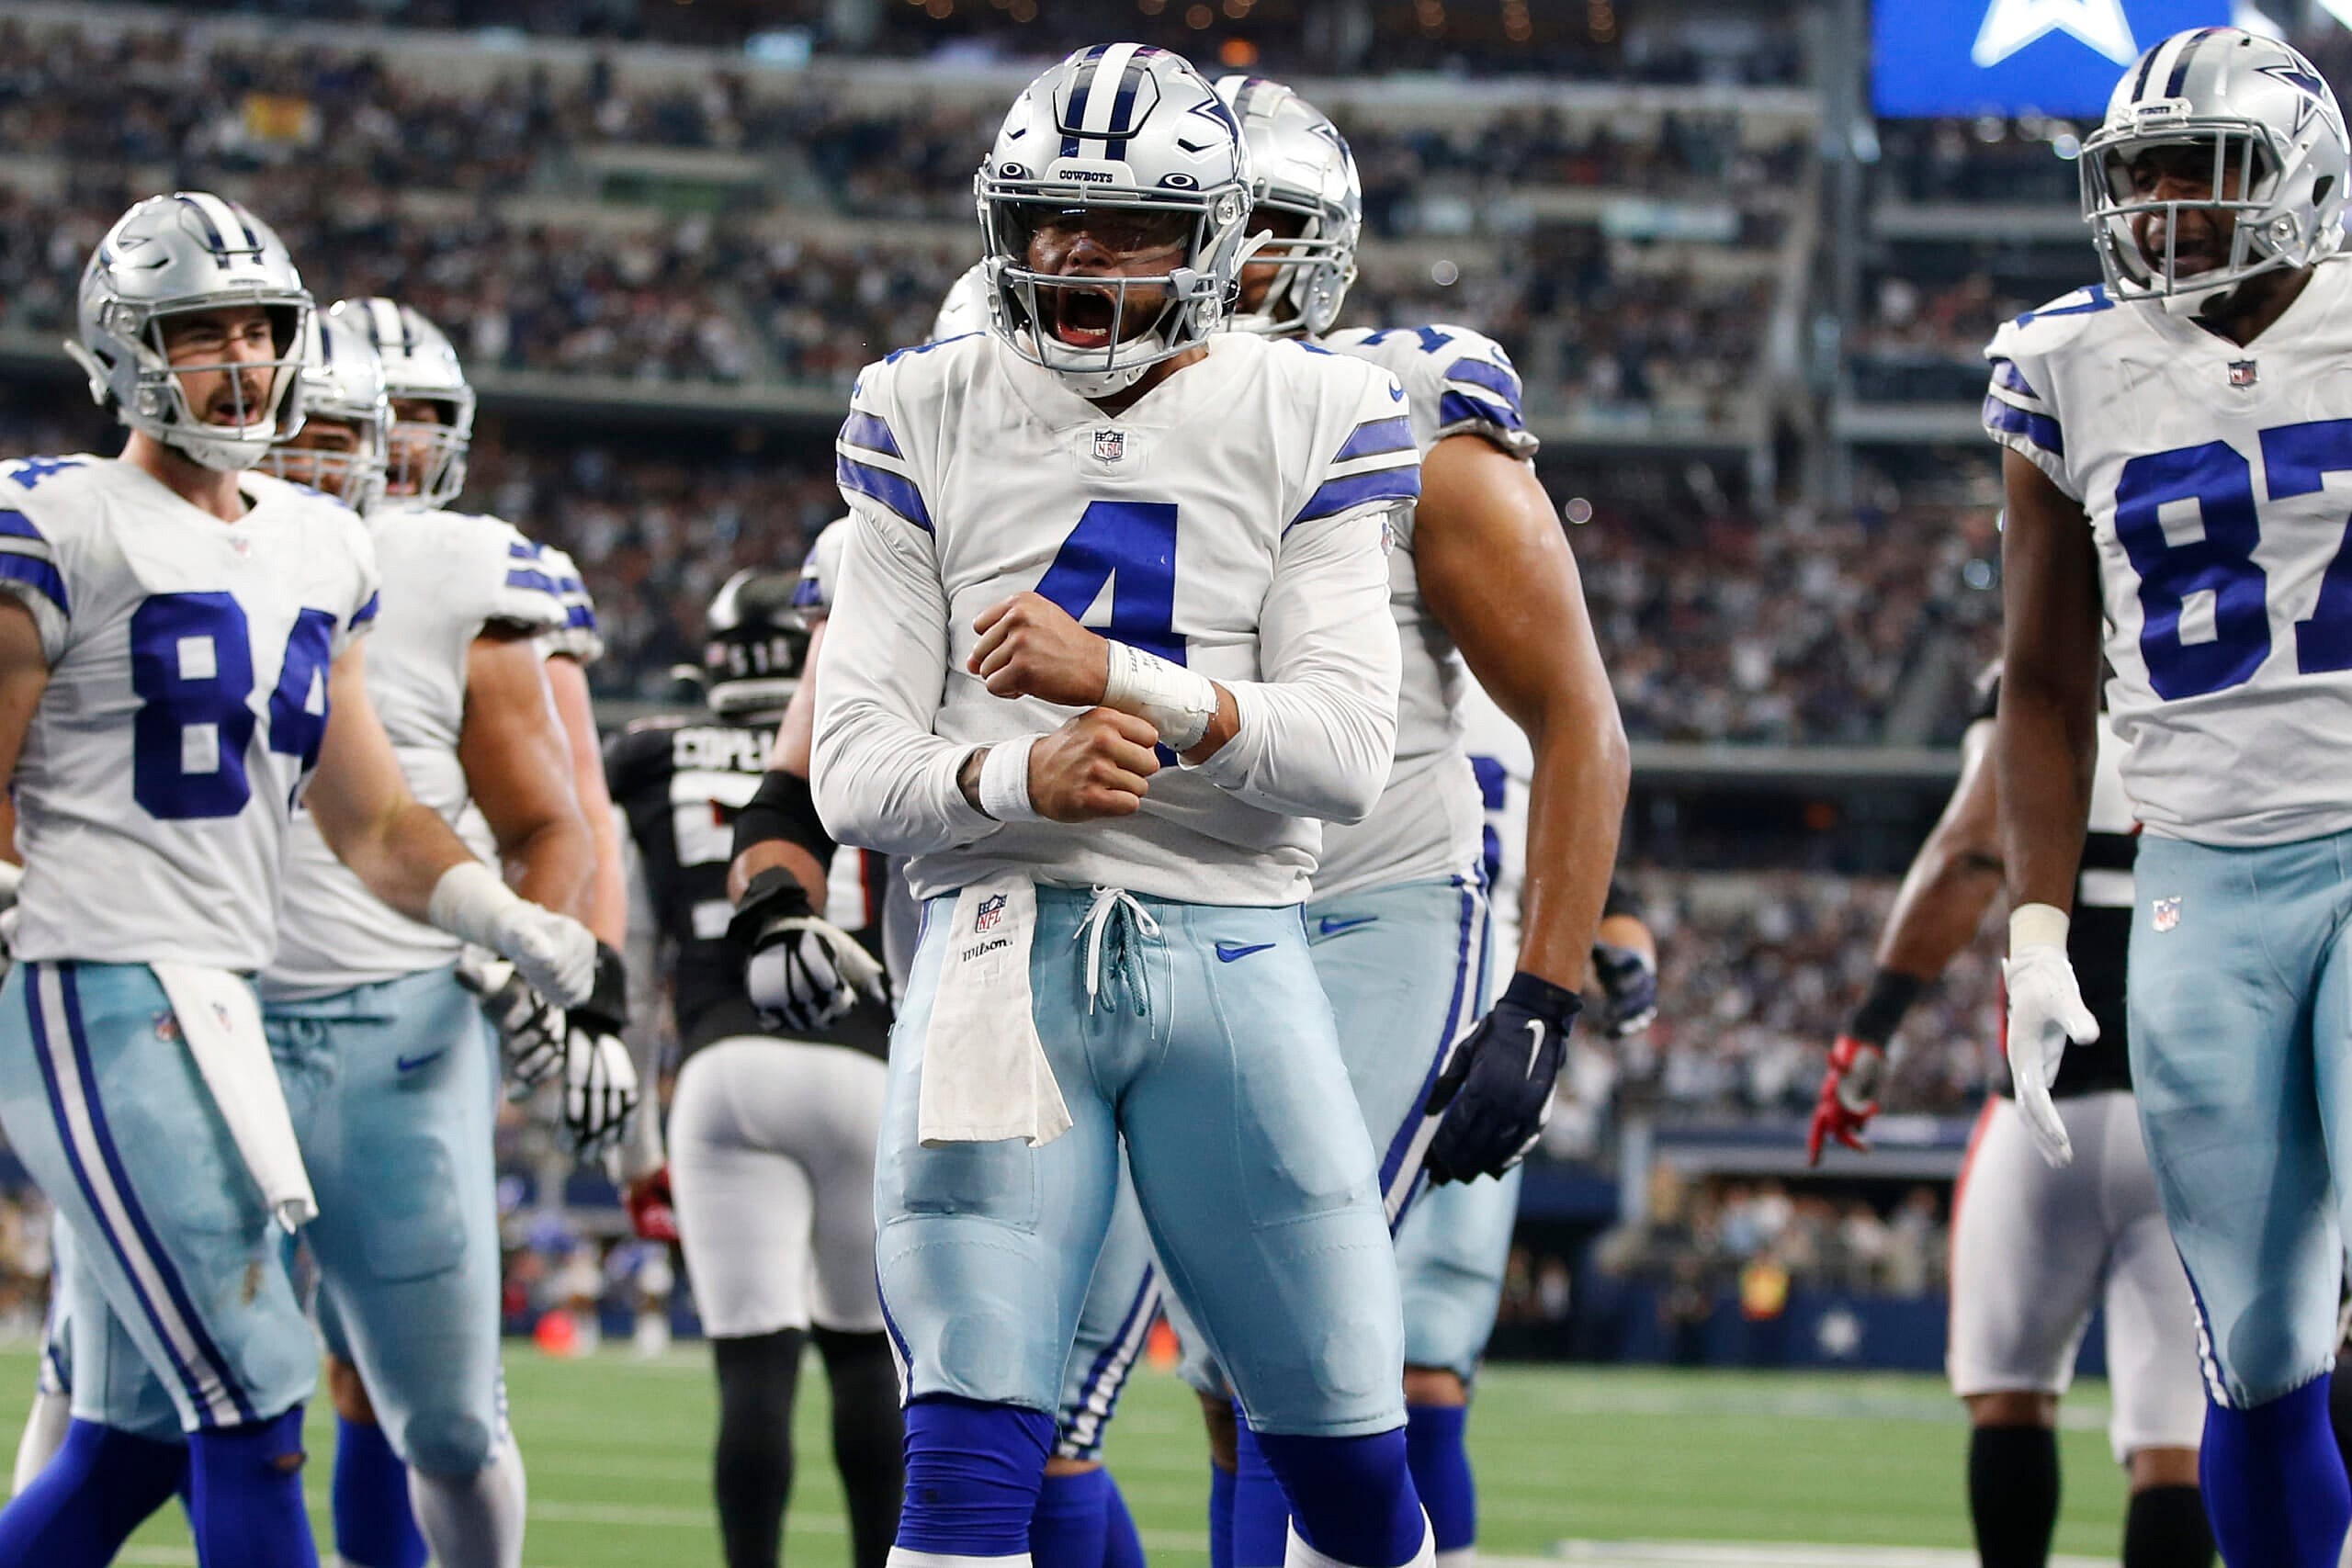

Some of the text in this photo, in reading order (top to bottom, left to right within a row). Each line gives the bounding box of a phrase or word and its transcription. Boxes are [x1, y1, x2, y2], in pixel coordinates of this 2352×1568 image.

[1058, 170, 1114, 183] COWBOYS
[1027, 501, 1188, 765] 4
[2114, 418, 2352, 702] 87
[130, 591, 337, 820] 84
[978, 908, 1001, 930] NFL
